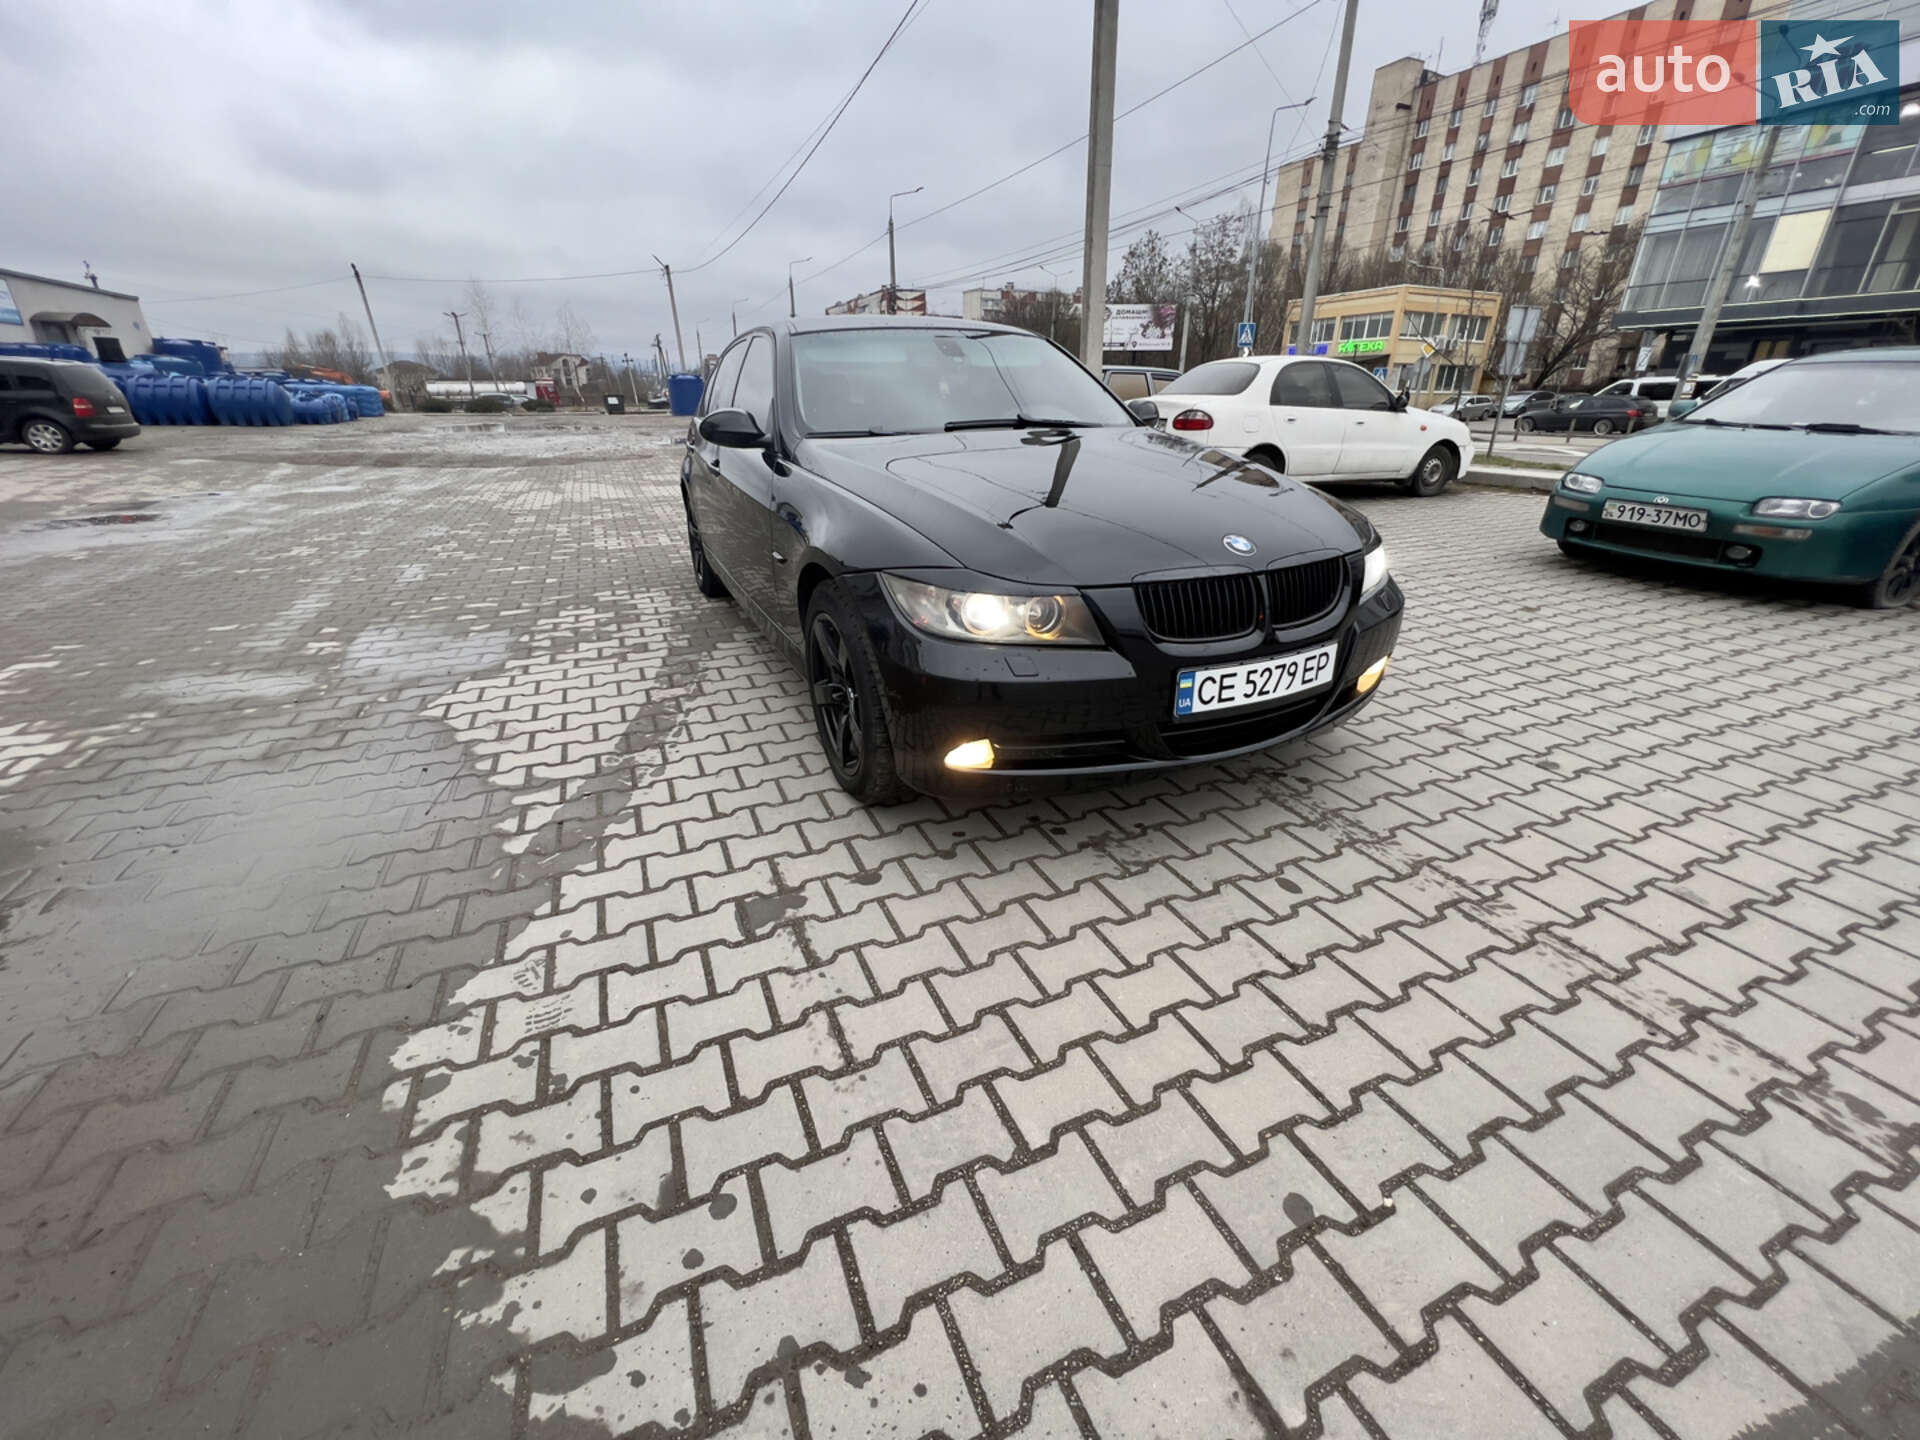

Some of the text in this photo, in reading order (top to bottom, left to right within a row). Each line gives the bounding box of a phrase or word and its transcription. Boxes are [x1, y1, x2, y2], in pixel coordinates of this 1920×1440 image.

[1617, 504, 1701, 528] 919-37MO
[1197, 652, 1330, 705] CE 5279 EP
[1178, 698, 1192, 708] UA
